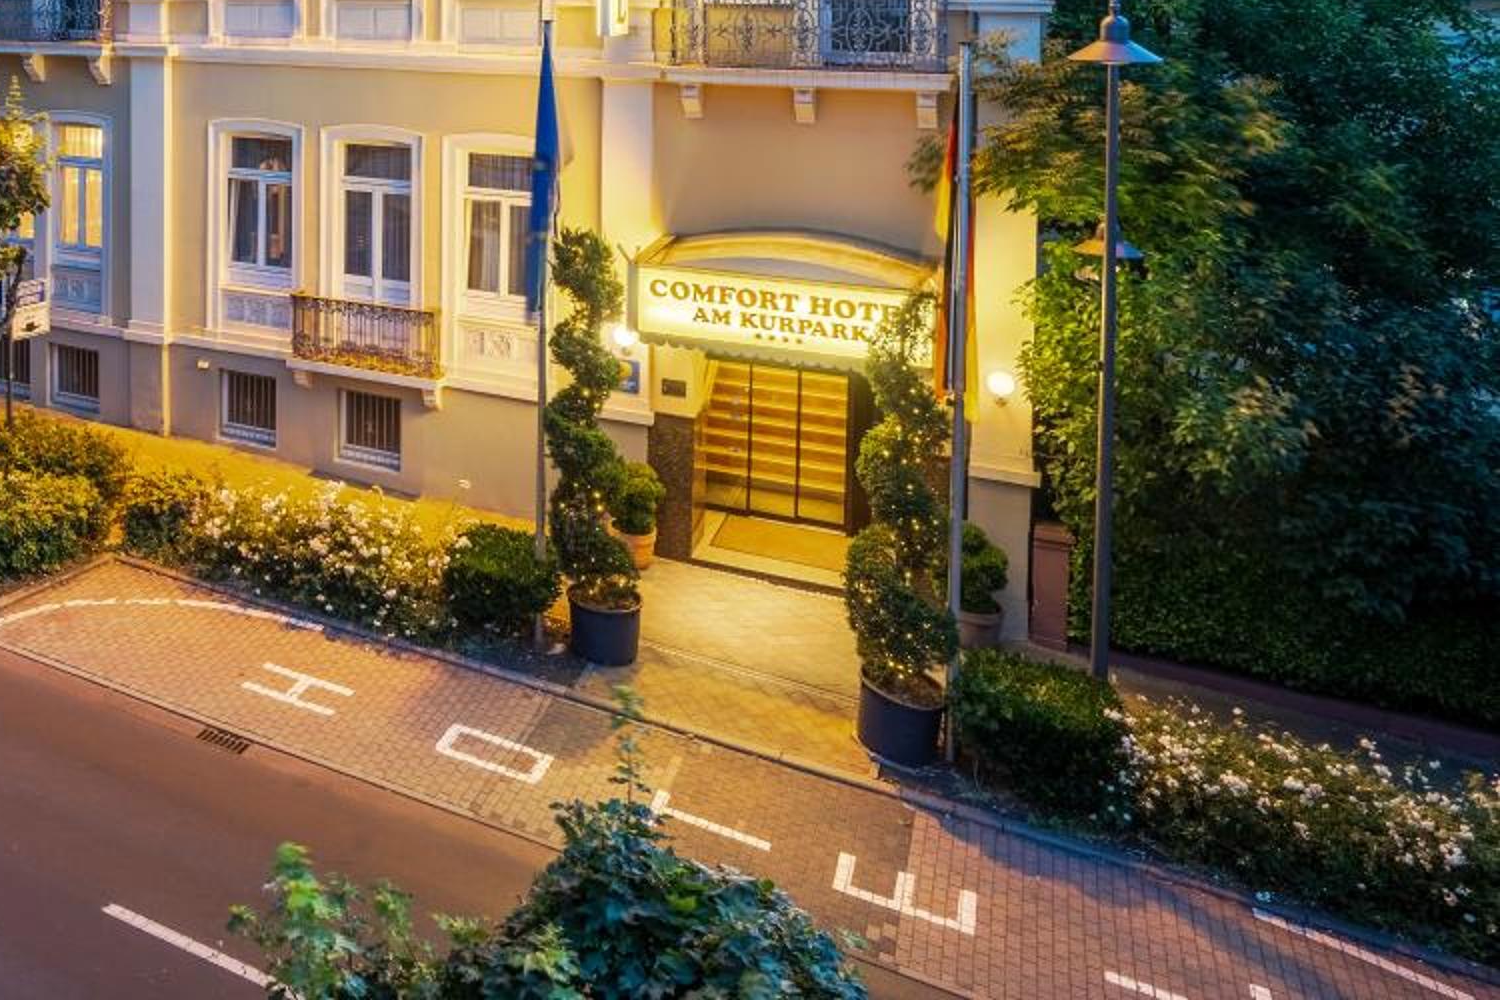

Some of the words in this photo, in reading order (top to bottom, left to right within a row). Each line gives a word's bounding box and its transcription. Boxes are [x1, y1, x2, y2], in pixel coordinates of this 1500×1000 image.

[649, 278, 800, 313] COMFORT
[809, 295, 902, 326] HOTE
[692, 306, 733, 326] AM
[739, 313, 871, 343] KURPARK
